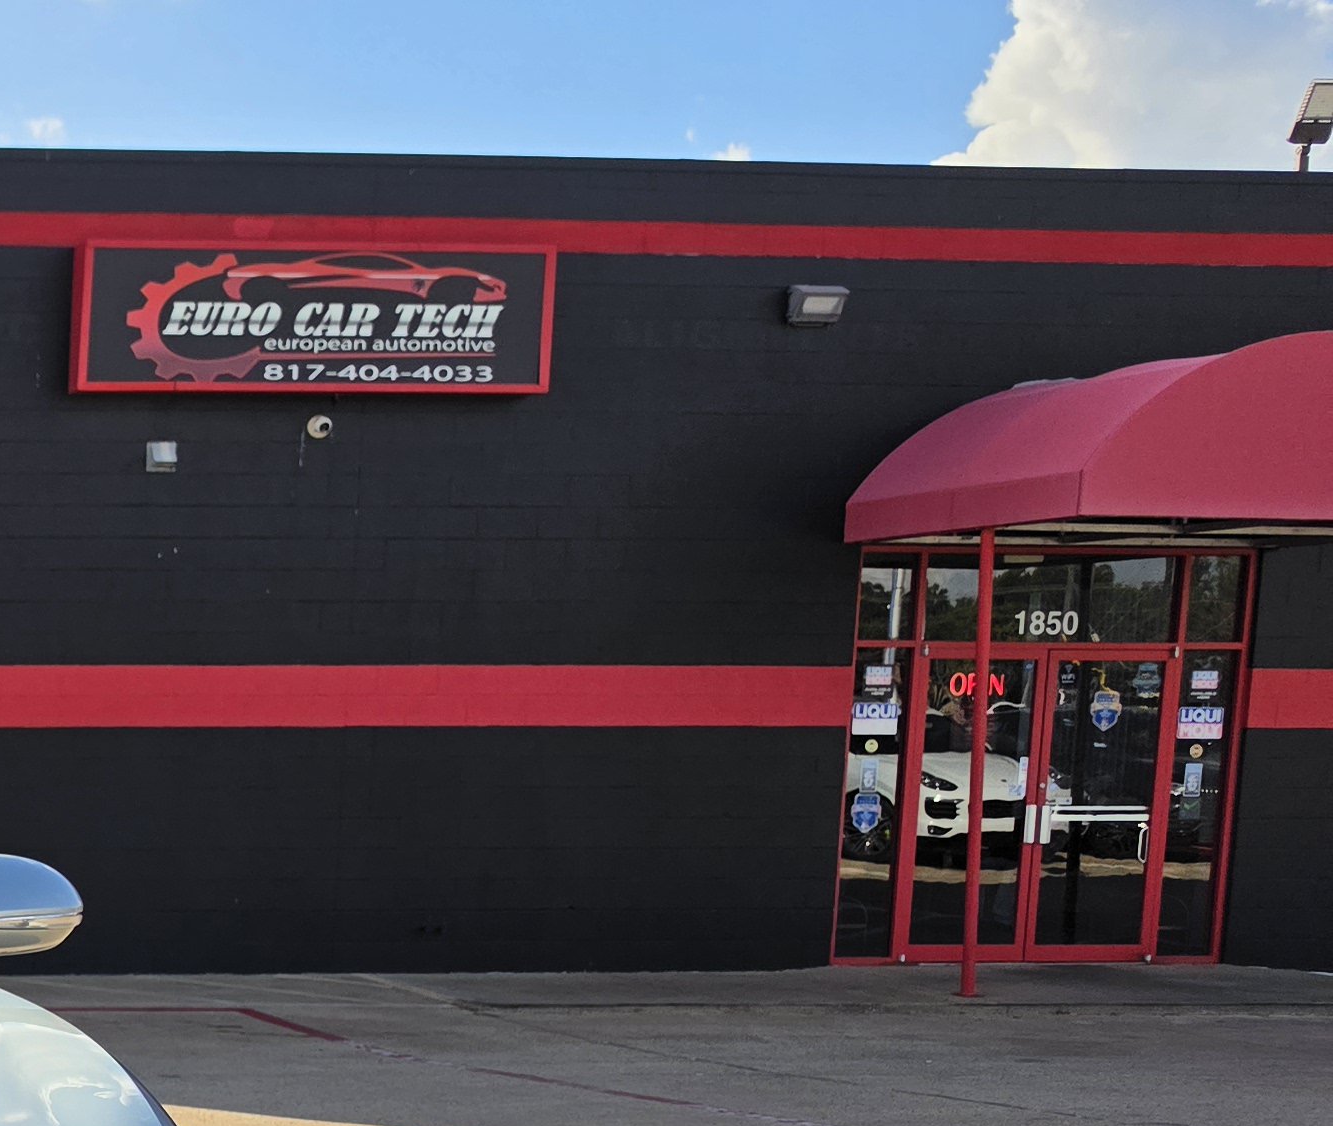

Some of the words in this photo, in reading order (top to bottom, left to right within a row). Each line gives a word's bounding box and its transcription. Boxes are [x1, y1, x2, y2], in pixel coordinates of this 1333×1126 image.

[162, 301, 282, 336] EURO
[293, 302, 381, 337] CAR
[391, 303, 504, 338] TECH
[264, 337, 367, 354] european
[372, 337, 496, 352] automotive
[263, 363, 493, 382] 817-404-4033
[1014, 610, 1079, 636] 1850
[855, 703, 897, 718] LIQUI
[1180, 708, 1222, 723] LIQUI
